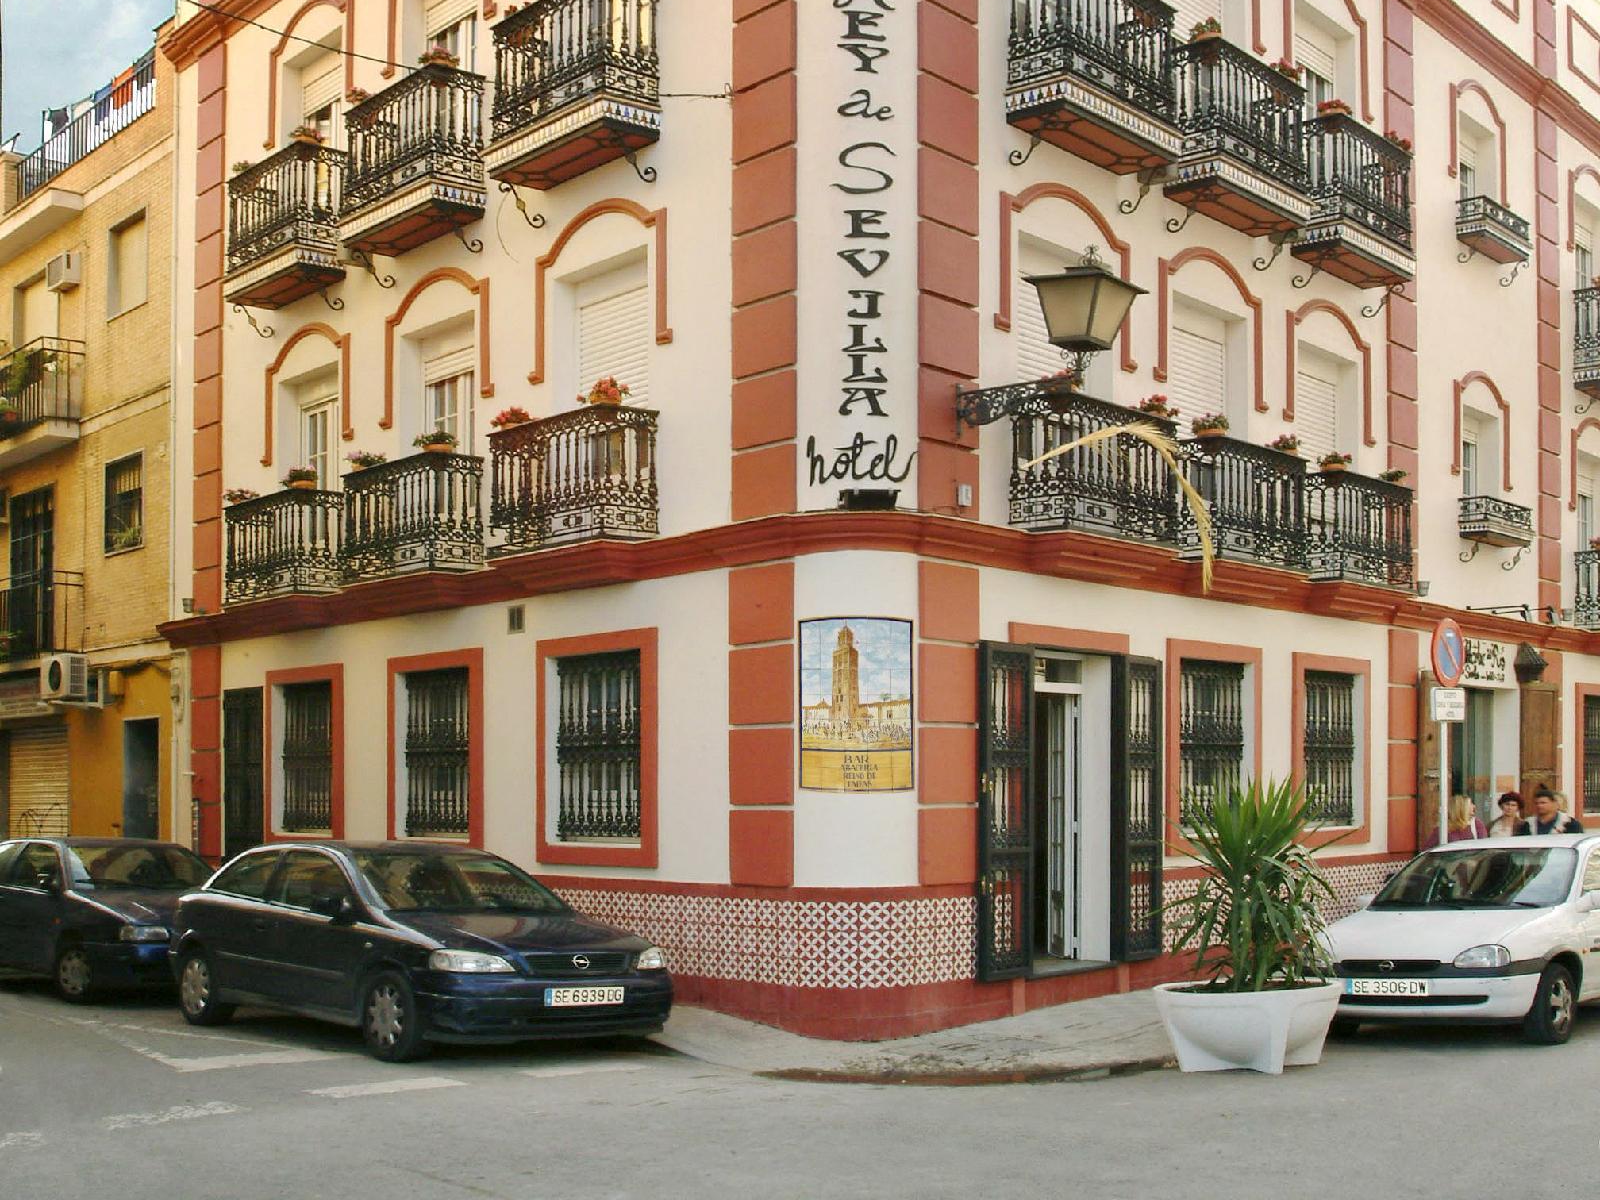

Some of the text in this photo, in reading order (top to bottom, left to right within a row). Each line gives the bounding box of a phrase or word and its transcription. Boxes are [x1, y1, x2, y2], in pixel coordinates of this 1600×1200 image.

[836, 89, 895, 121] de
[830, 142, 897, 418] SEVILLA
[806, 432, 918, 487] hotel
[844, 755, 869, 763] BAR
[554, 990, 570, 1003] SE
[572, 990, 605, 1002] 6939
[1354, 981, 1369, 993] SE
[1409, 981, 1426, 994] DW
